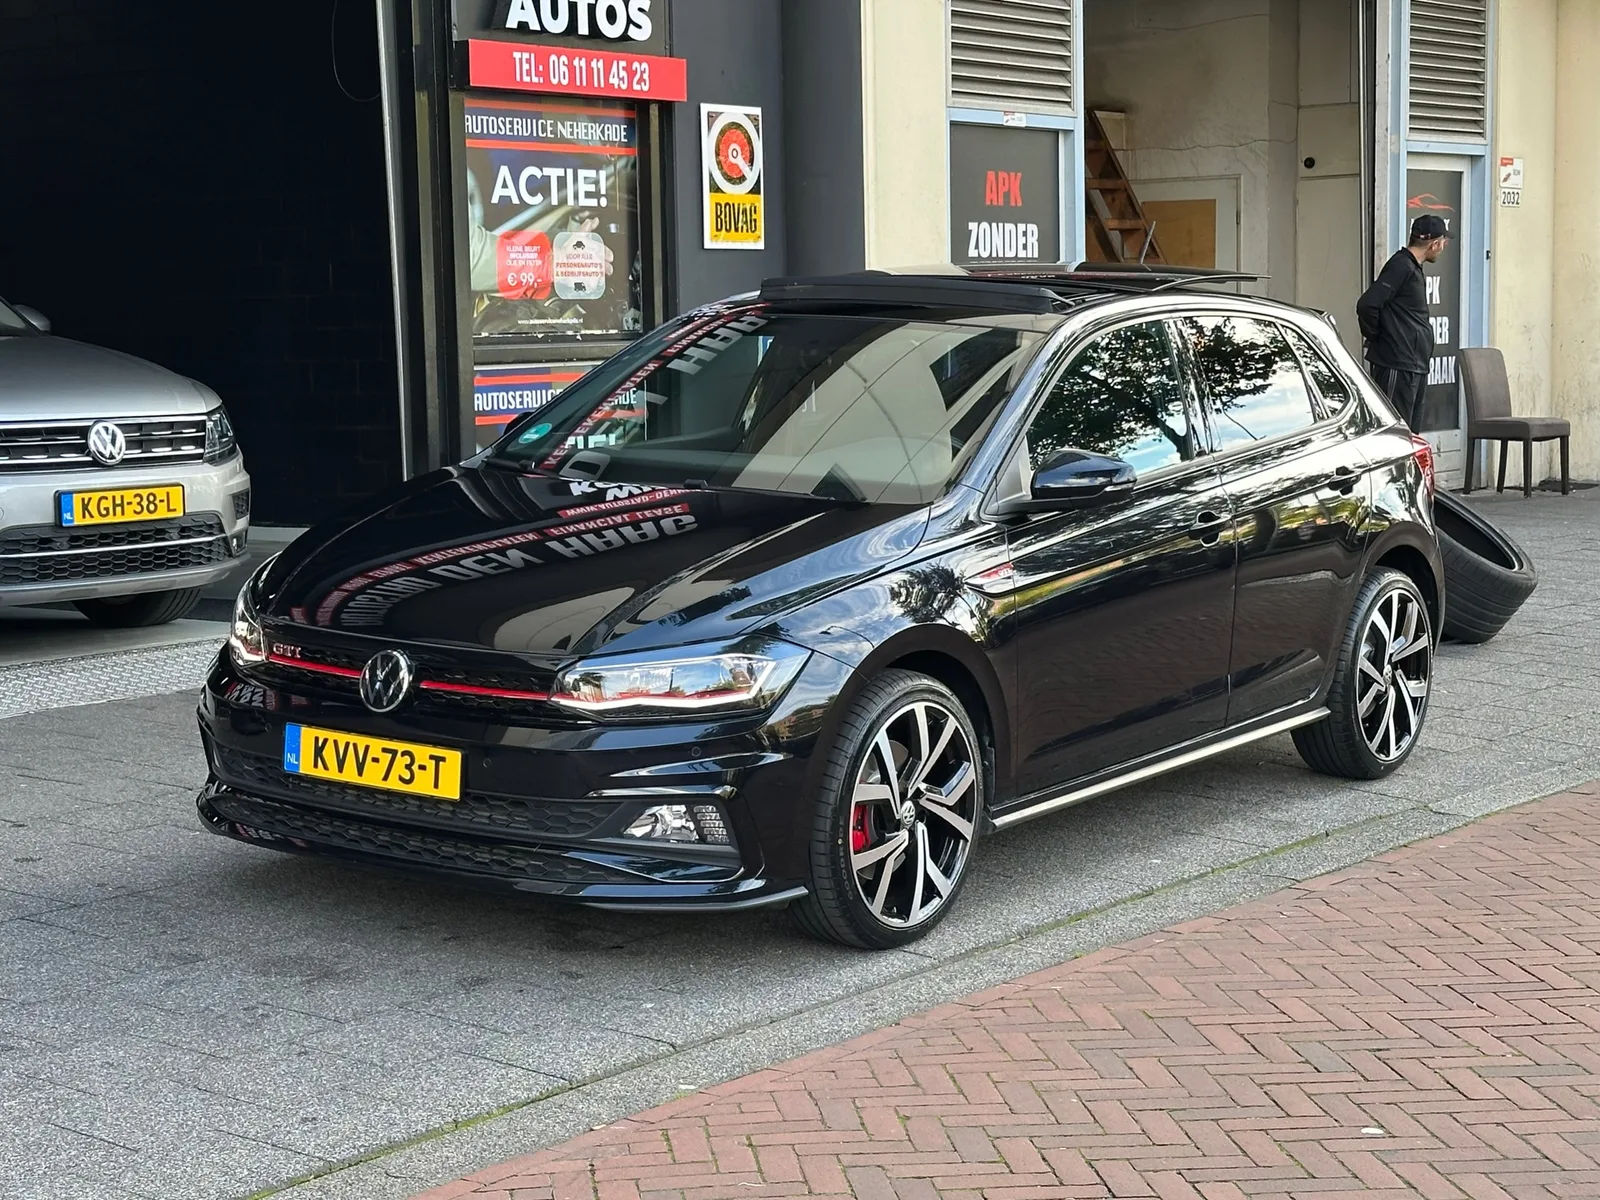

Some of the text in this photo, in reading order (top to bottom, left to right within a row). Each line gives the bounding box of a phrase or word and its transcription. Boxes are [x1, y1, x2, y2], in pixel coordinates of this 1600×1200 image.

[505, 0, 653, 42] AUTOS
[513, 51, 650, 92] TEL: 06 11 11 45 23
[465, 114, 628, 143] AUTOSERVICE NEHERKADE
[491, 164, 608, 208] ACTIE!
[985, 170, 1022, 207] APK
[1502, 191, 1520, 205] 2032
[715, 201, 758, 234] BOVAG
[968, 222, 1039, 259] ZONDER
[507, 272, 543, 288] € 99,-
[1426, 276, 1441, 304] PK
[474, 388, 563, 412] AUTOSERVIC
[63, 512, 73, 521] NL
[80, 491, 177, 519] KGH-38-L
[272, 642, 301, 658] GTI
[287, 752, 299, 765] NL
[313, 736, 447, 790] KVV-73-T
